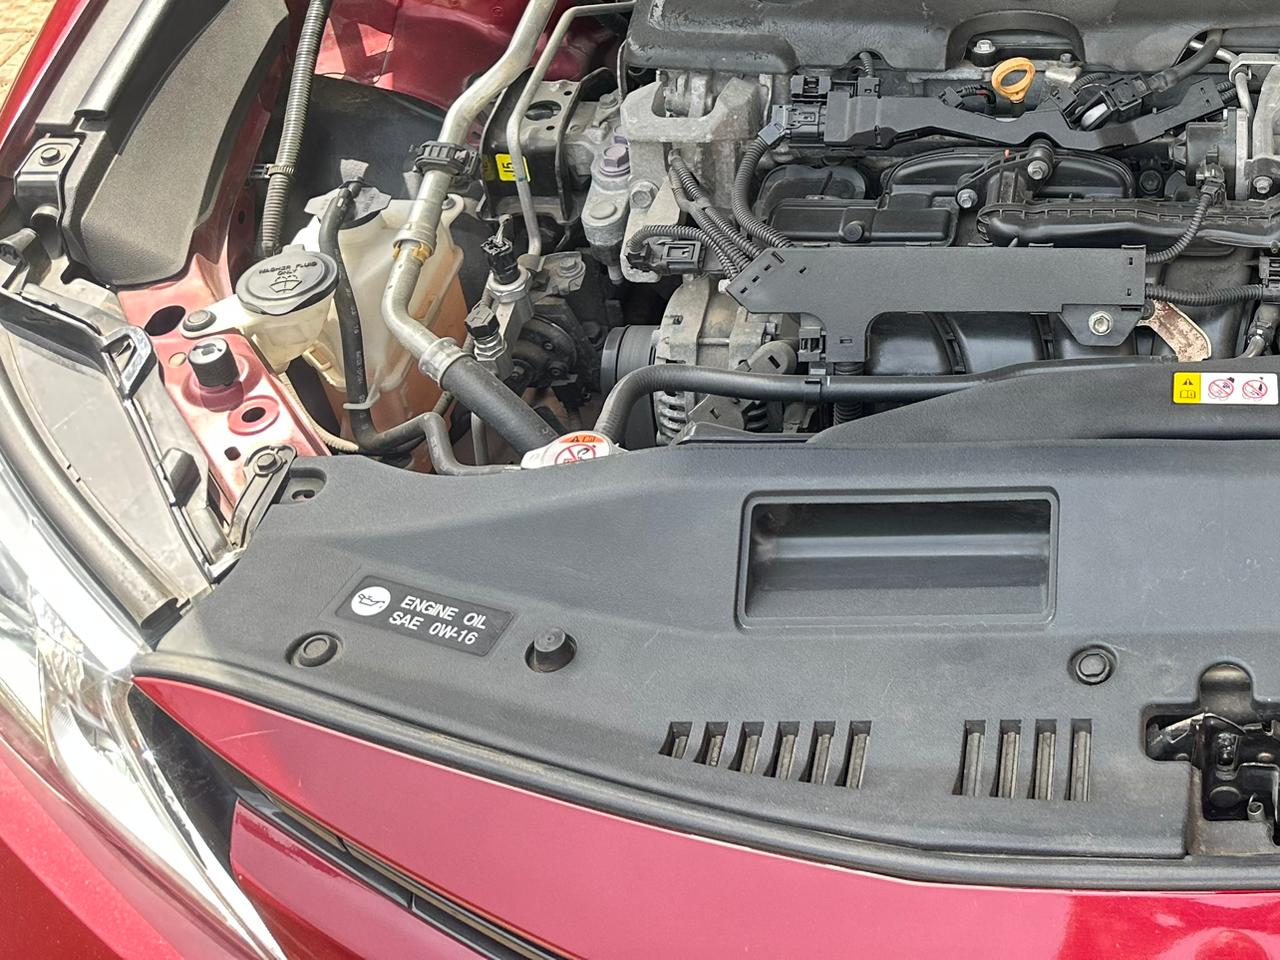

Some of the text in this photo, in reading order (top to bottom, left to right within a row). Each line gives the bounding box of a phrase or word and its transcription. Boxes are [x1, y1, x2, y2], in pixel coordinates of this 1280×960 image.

[389, 611, 478, 645] SAE 0W-16
[400, 595, 487, 630] ENGINE OIL
